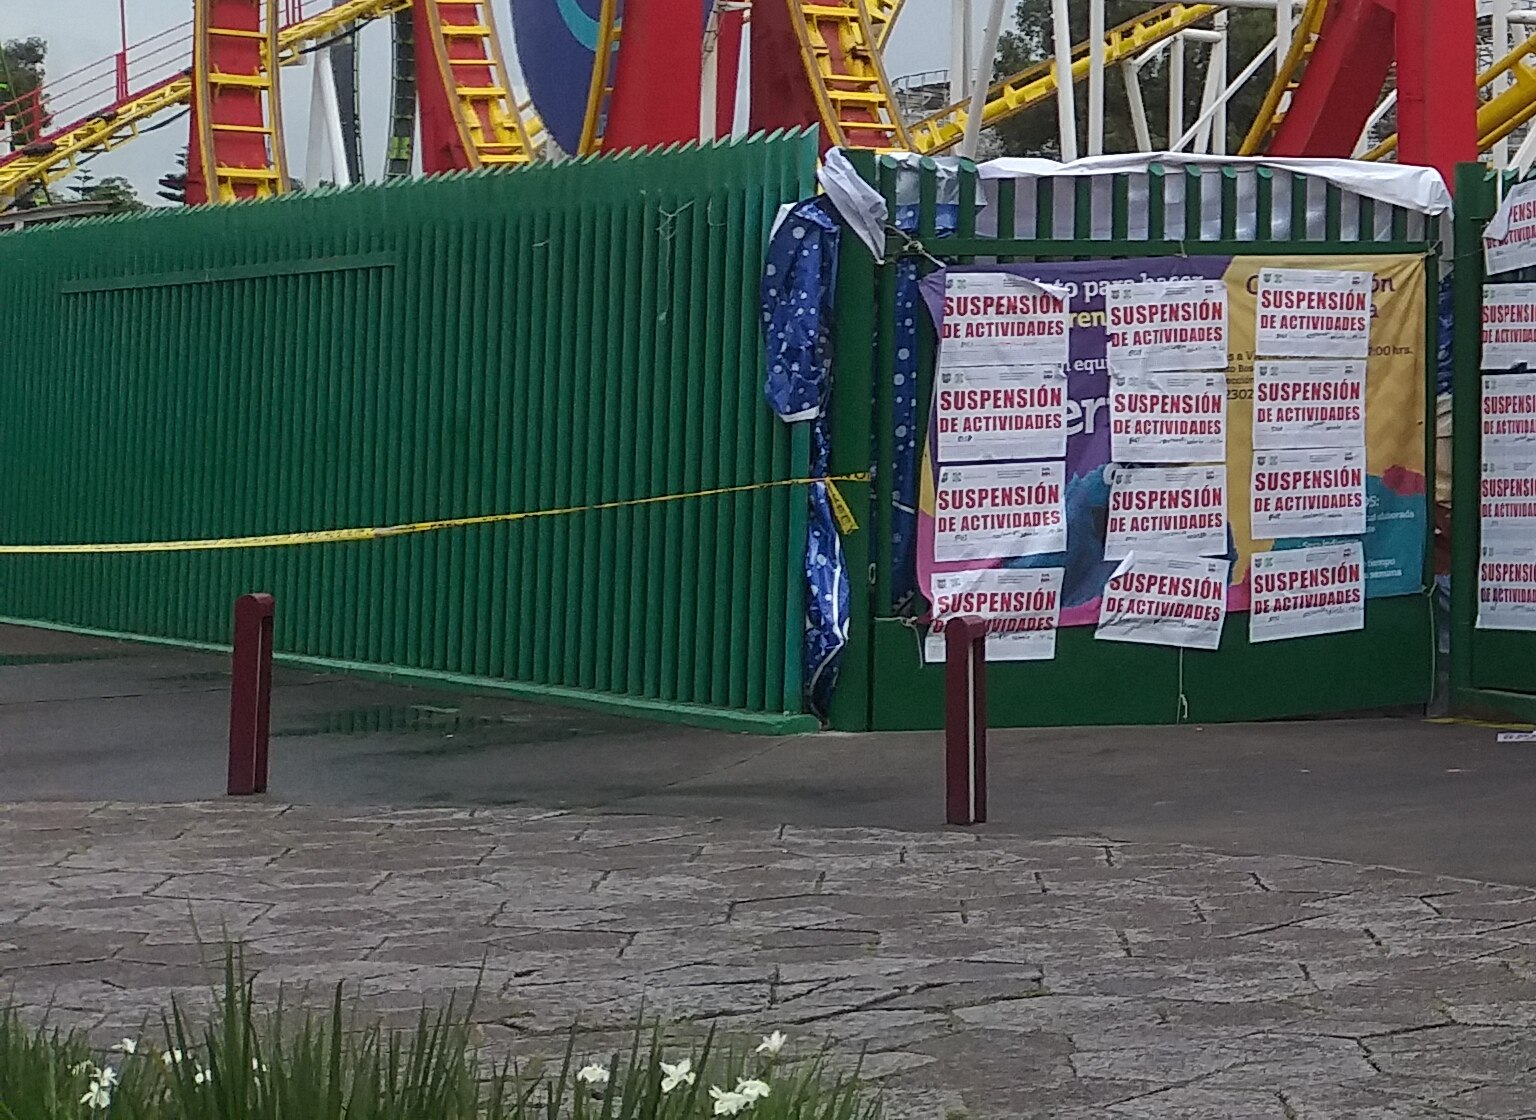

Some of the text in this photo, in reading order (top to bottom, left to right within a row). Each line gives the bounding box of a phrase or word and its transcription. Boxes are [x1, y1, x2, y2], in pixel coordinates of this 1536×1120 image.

[1262, 291, 1365, 310] SUSPENSIÓN
[1111, 301, 1222, 325] SUSPENSIÓN
[1261, 316, 1366, 330] DE ACTIVIDADES
[1112, 328, 1221, 347] DE ACTIVIDADES
[941, 387, 1061, 410] SUSPENSIÓN
[1259, 380, 1360, 401] SUSPENSIÓN
[940, 414, 1061, 432] DE ACTIVIDADES
[1258, 406, 1360, 421] DE ACTIVIDADES
[1256, 469, 1360, 491] SUSPENSIÓN
[939, 484, 1059, 510] SUSPENSIÓN
[1114, 488, 1222, 510] SUSPENSIÓN
[1255, 498, 1269, 512] DE
[1275, 493, 1361, 511] ACTIVIDADES
[938, 511, 1060, 532] DE ACTIVIDADES
[1110, 514, 1222, 532] DE ACTIVIDADES
[1110, 573, 1222, 599] SUSPENSIÓN
[1254, 565, 1359, 594] SUSPENSIÓN
[938, 591, 1055, 613] SUSPENSIÓN
[1107, 598, 1219, 621] DE ACTIVIDADES
[1254, 589, 1360, 613] DE ACTIVIDADES
